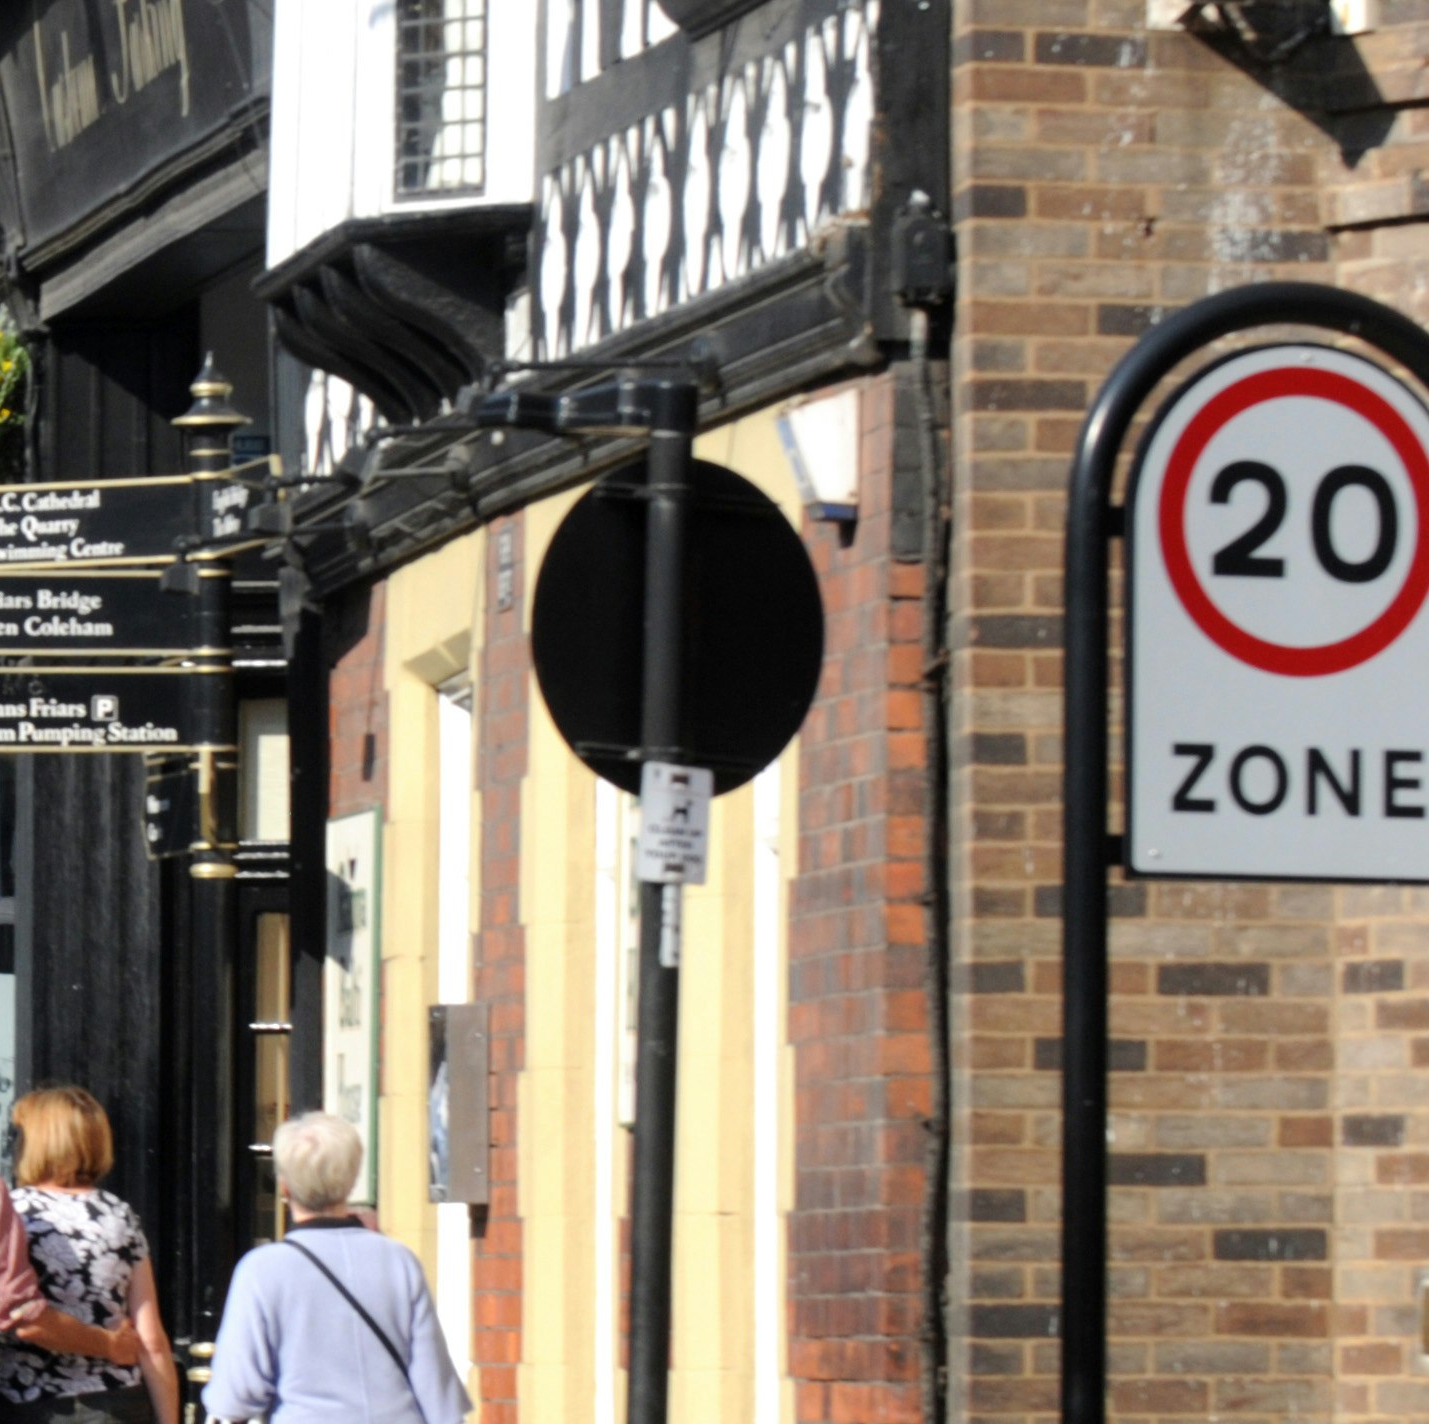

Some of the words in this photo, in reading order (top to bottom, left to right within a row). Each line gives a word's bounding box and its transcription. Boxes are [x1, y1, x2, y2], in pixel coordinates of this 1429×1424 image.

[22, 489, 101, 510] Cathedral
[20, 515, 79, 541] Quarry
[1208, 460, 1400, 584] 20
[70, 537, 125, 558] Centre
[36, 589, 103, 615] Bridge
[23, 615, 114, 637] Coleham
[29, 696, 86, 718] Friars
[18, 721, 106, 746] Pumping
[107, 721, 178, 742] Station
[1171, 743, 1425, 818] ZONE
